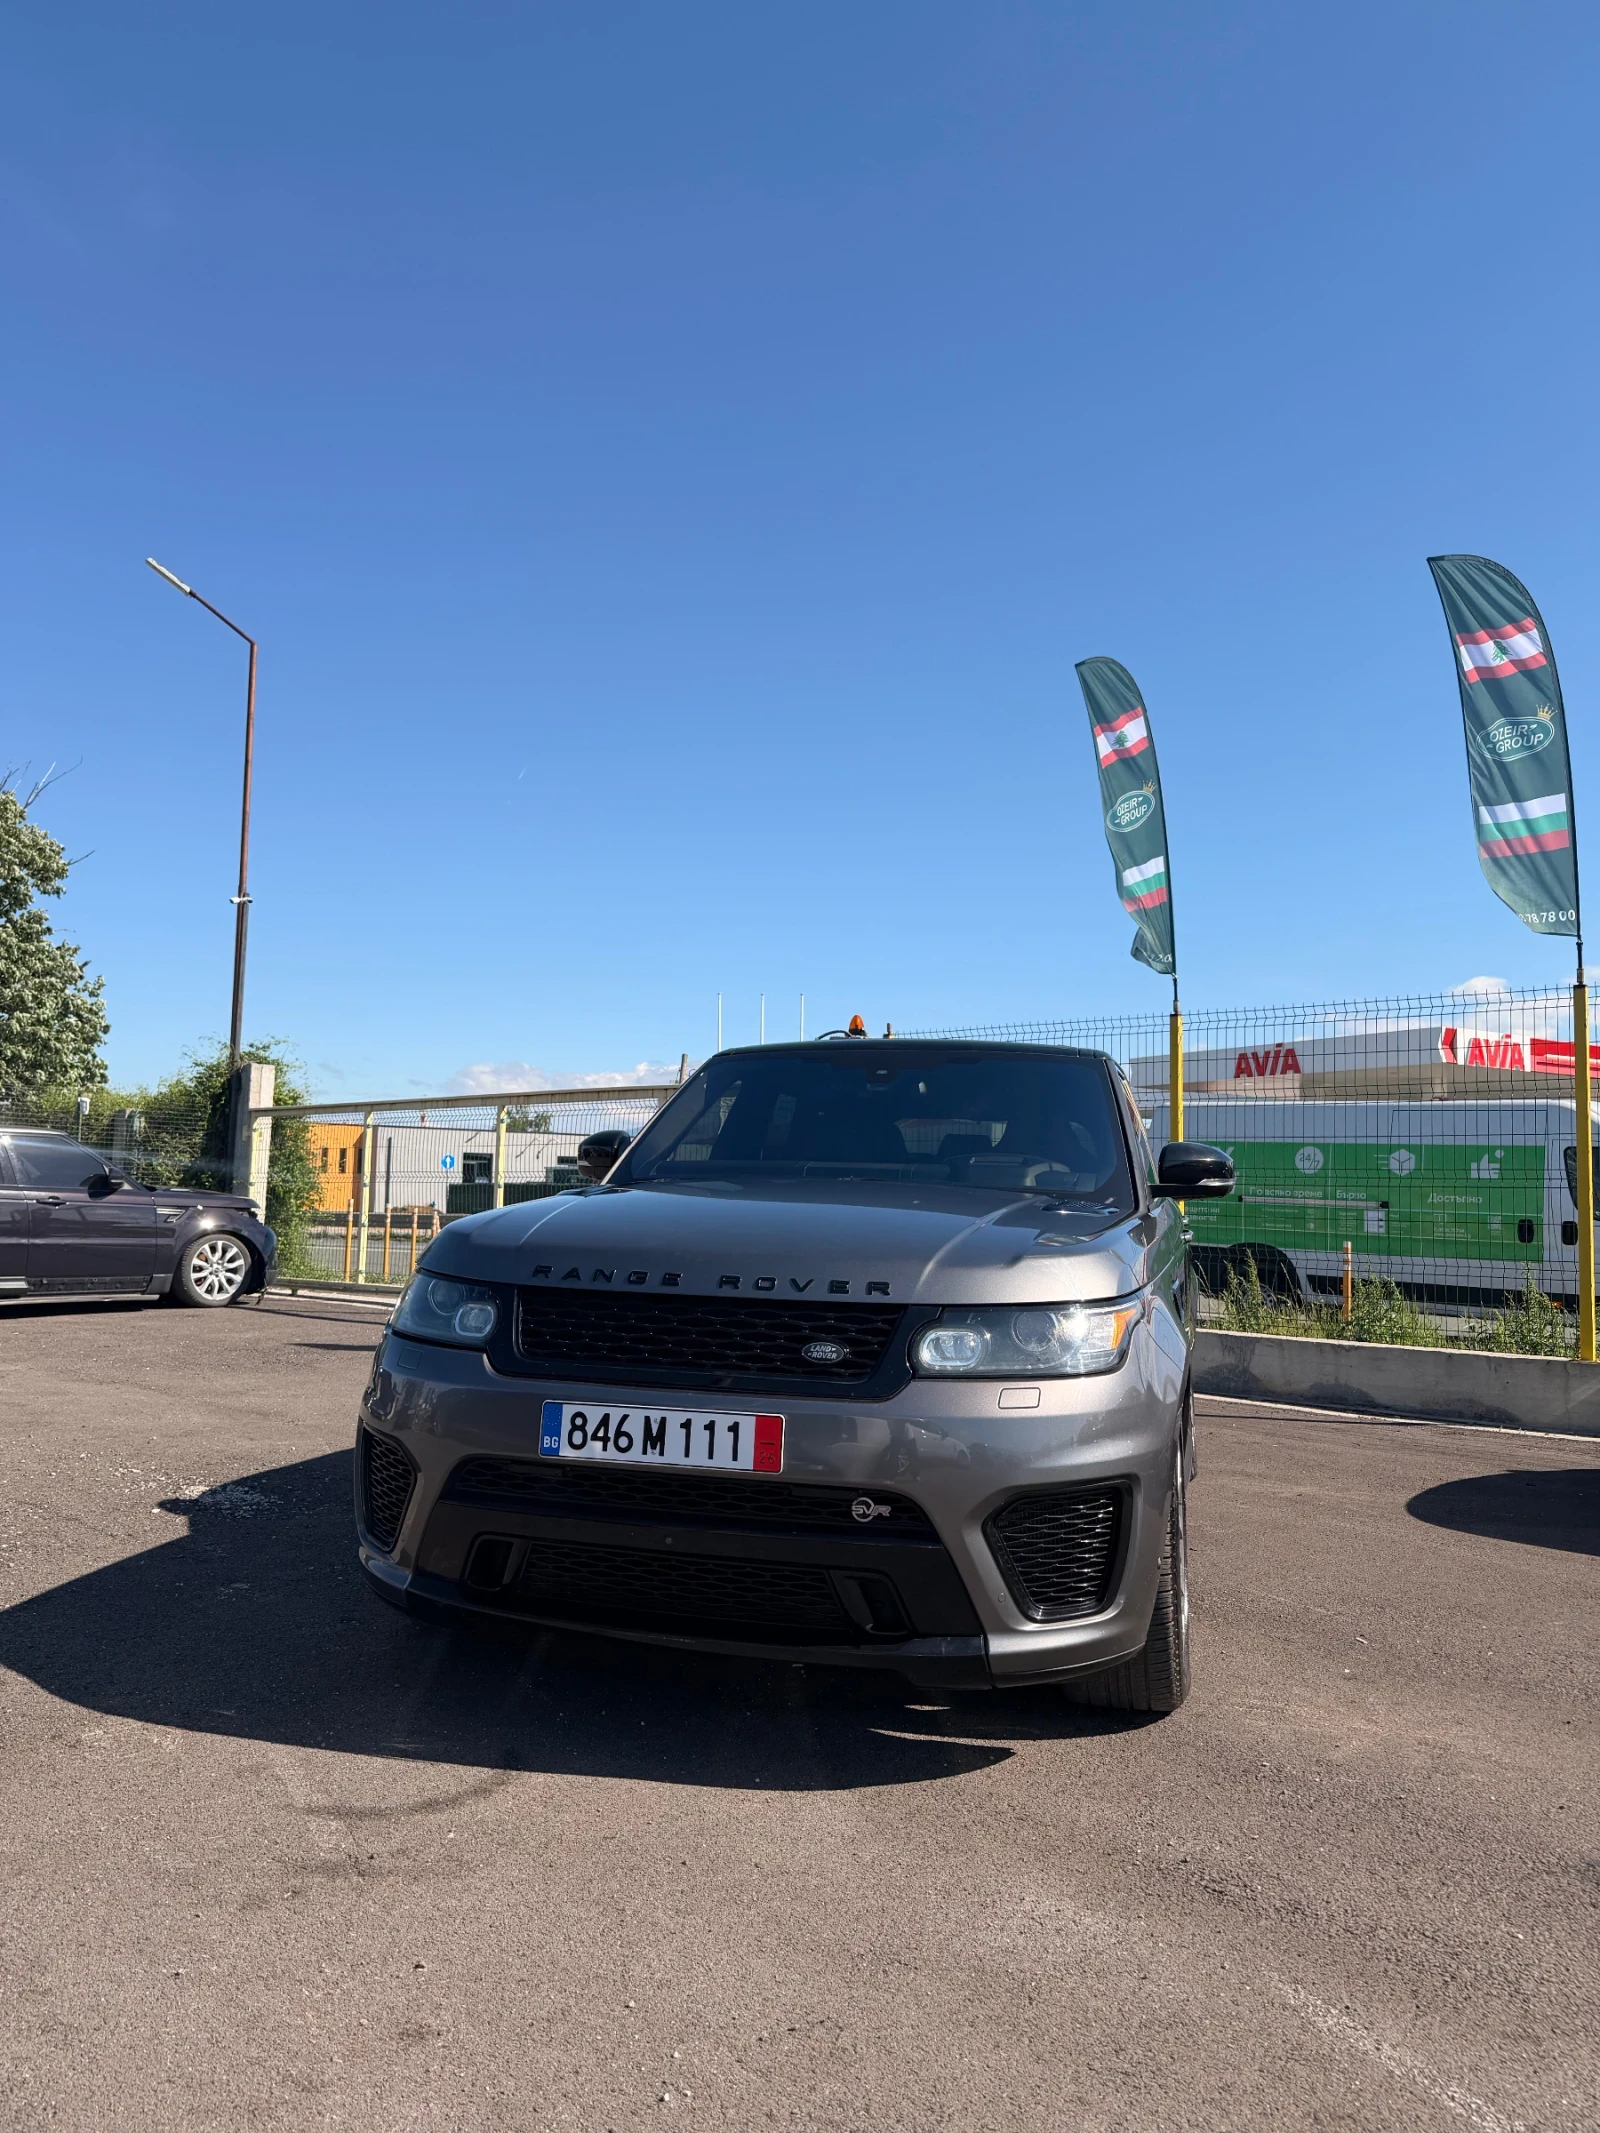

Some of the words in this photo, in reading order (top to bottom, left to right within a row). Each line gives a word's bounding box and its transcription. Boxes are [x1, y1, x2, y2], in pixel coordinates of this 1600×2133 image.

[1489, 724, 1528, 742] OZEIR
[1495, 733, 1544, 753] GROUP
[1116, 797, 1138, 817] OZEIR
[1120, 804, 1148, 826] GROUP
[1540, 911, 1557, 923] 78
[1558, 909, 1576, 922] 00
[532, 1264, 684, 1287] RANGE
[718, 1274, 892, 1296] ROVER
[810, 1344, 832, 1352] LAND
[811, 1351, 838, 1360] ROVER
[543, 1435, 559, 1449] BG
[567, 1411, 634, 1454] 846
[679, 1418, 740, 1462] 111
[851, 1497, 892, 1522] SVR
